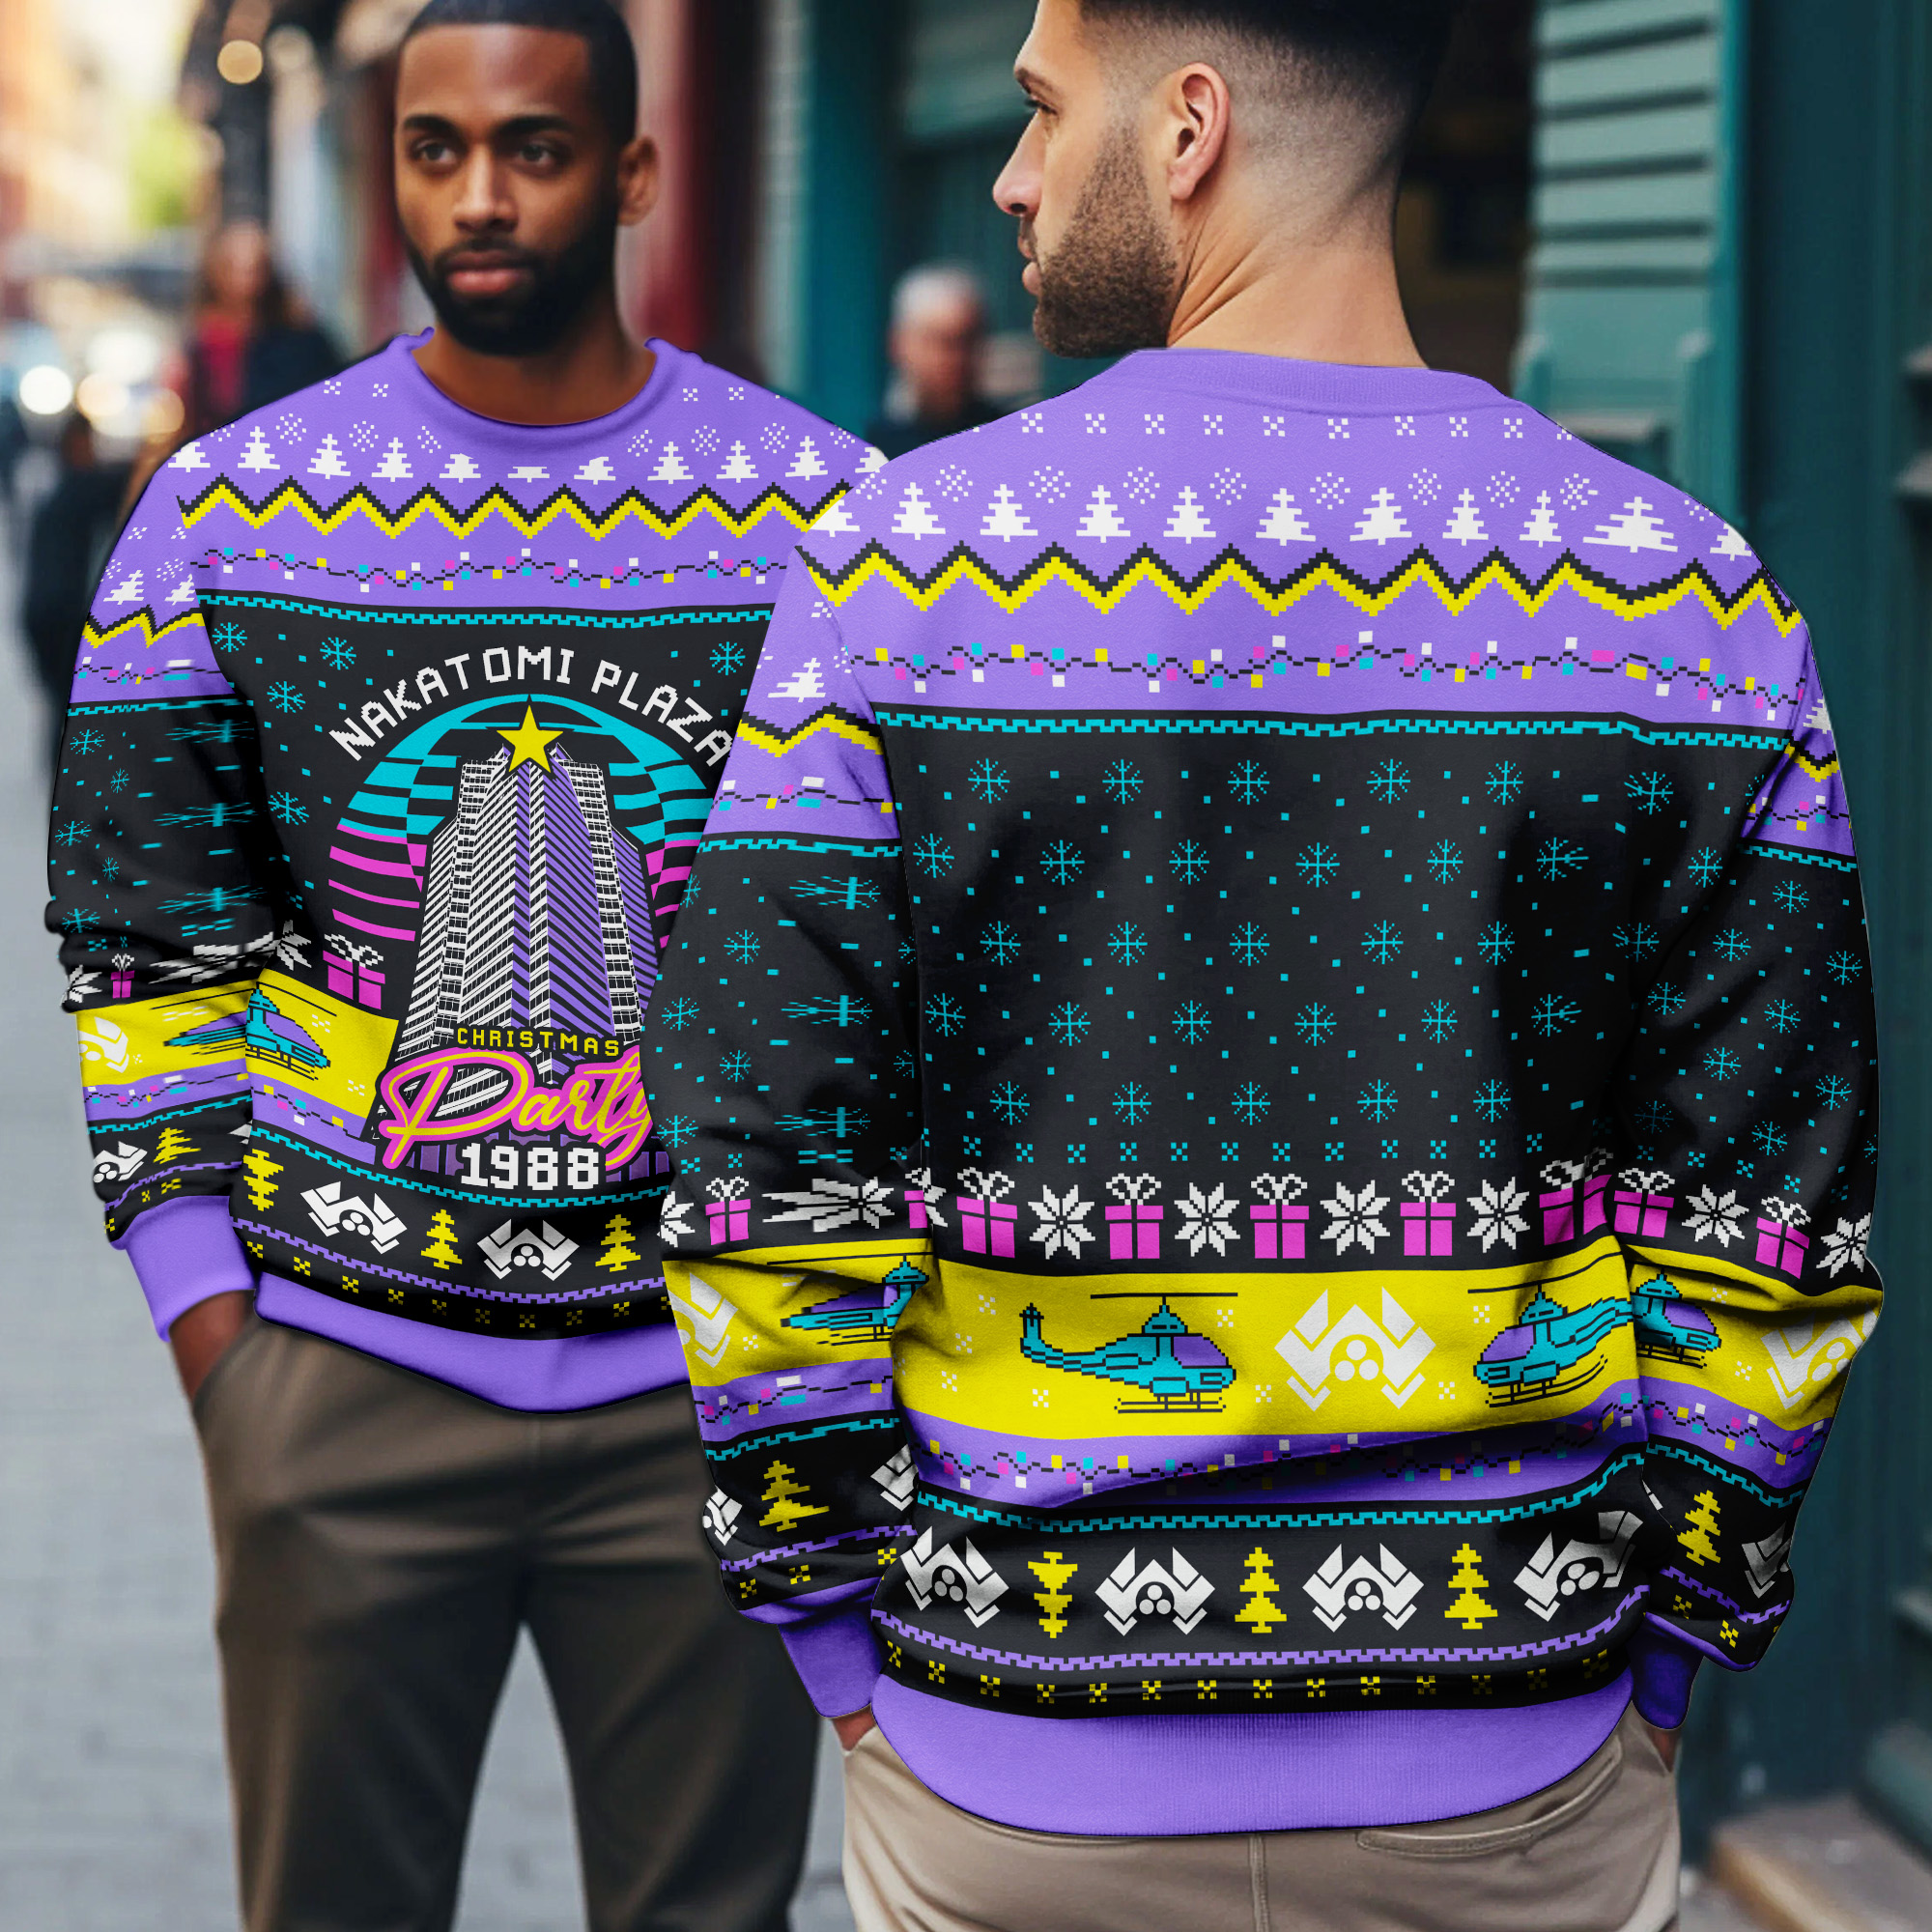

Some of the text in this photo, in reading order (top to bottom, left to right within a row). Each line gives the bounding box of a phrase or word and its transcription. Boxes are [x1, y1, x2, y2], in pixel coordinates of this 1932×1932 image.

[329, 645, 733, 767] NAKATOMI PLAZA
[457, 1028, 619, 1056] CHRISTMAS
[382, 1047, 652, 1168] Party
[461, 1143, 599, 1190] 1988
